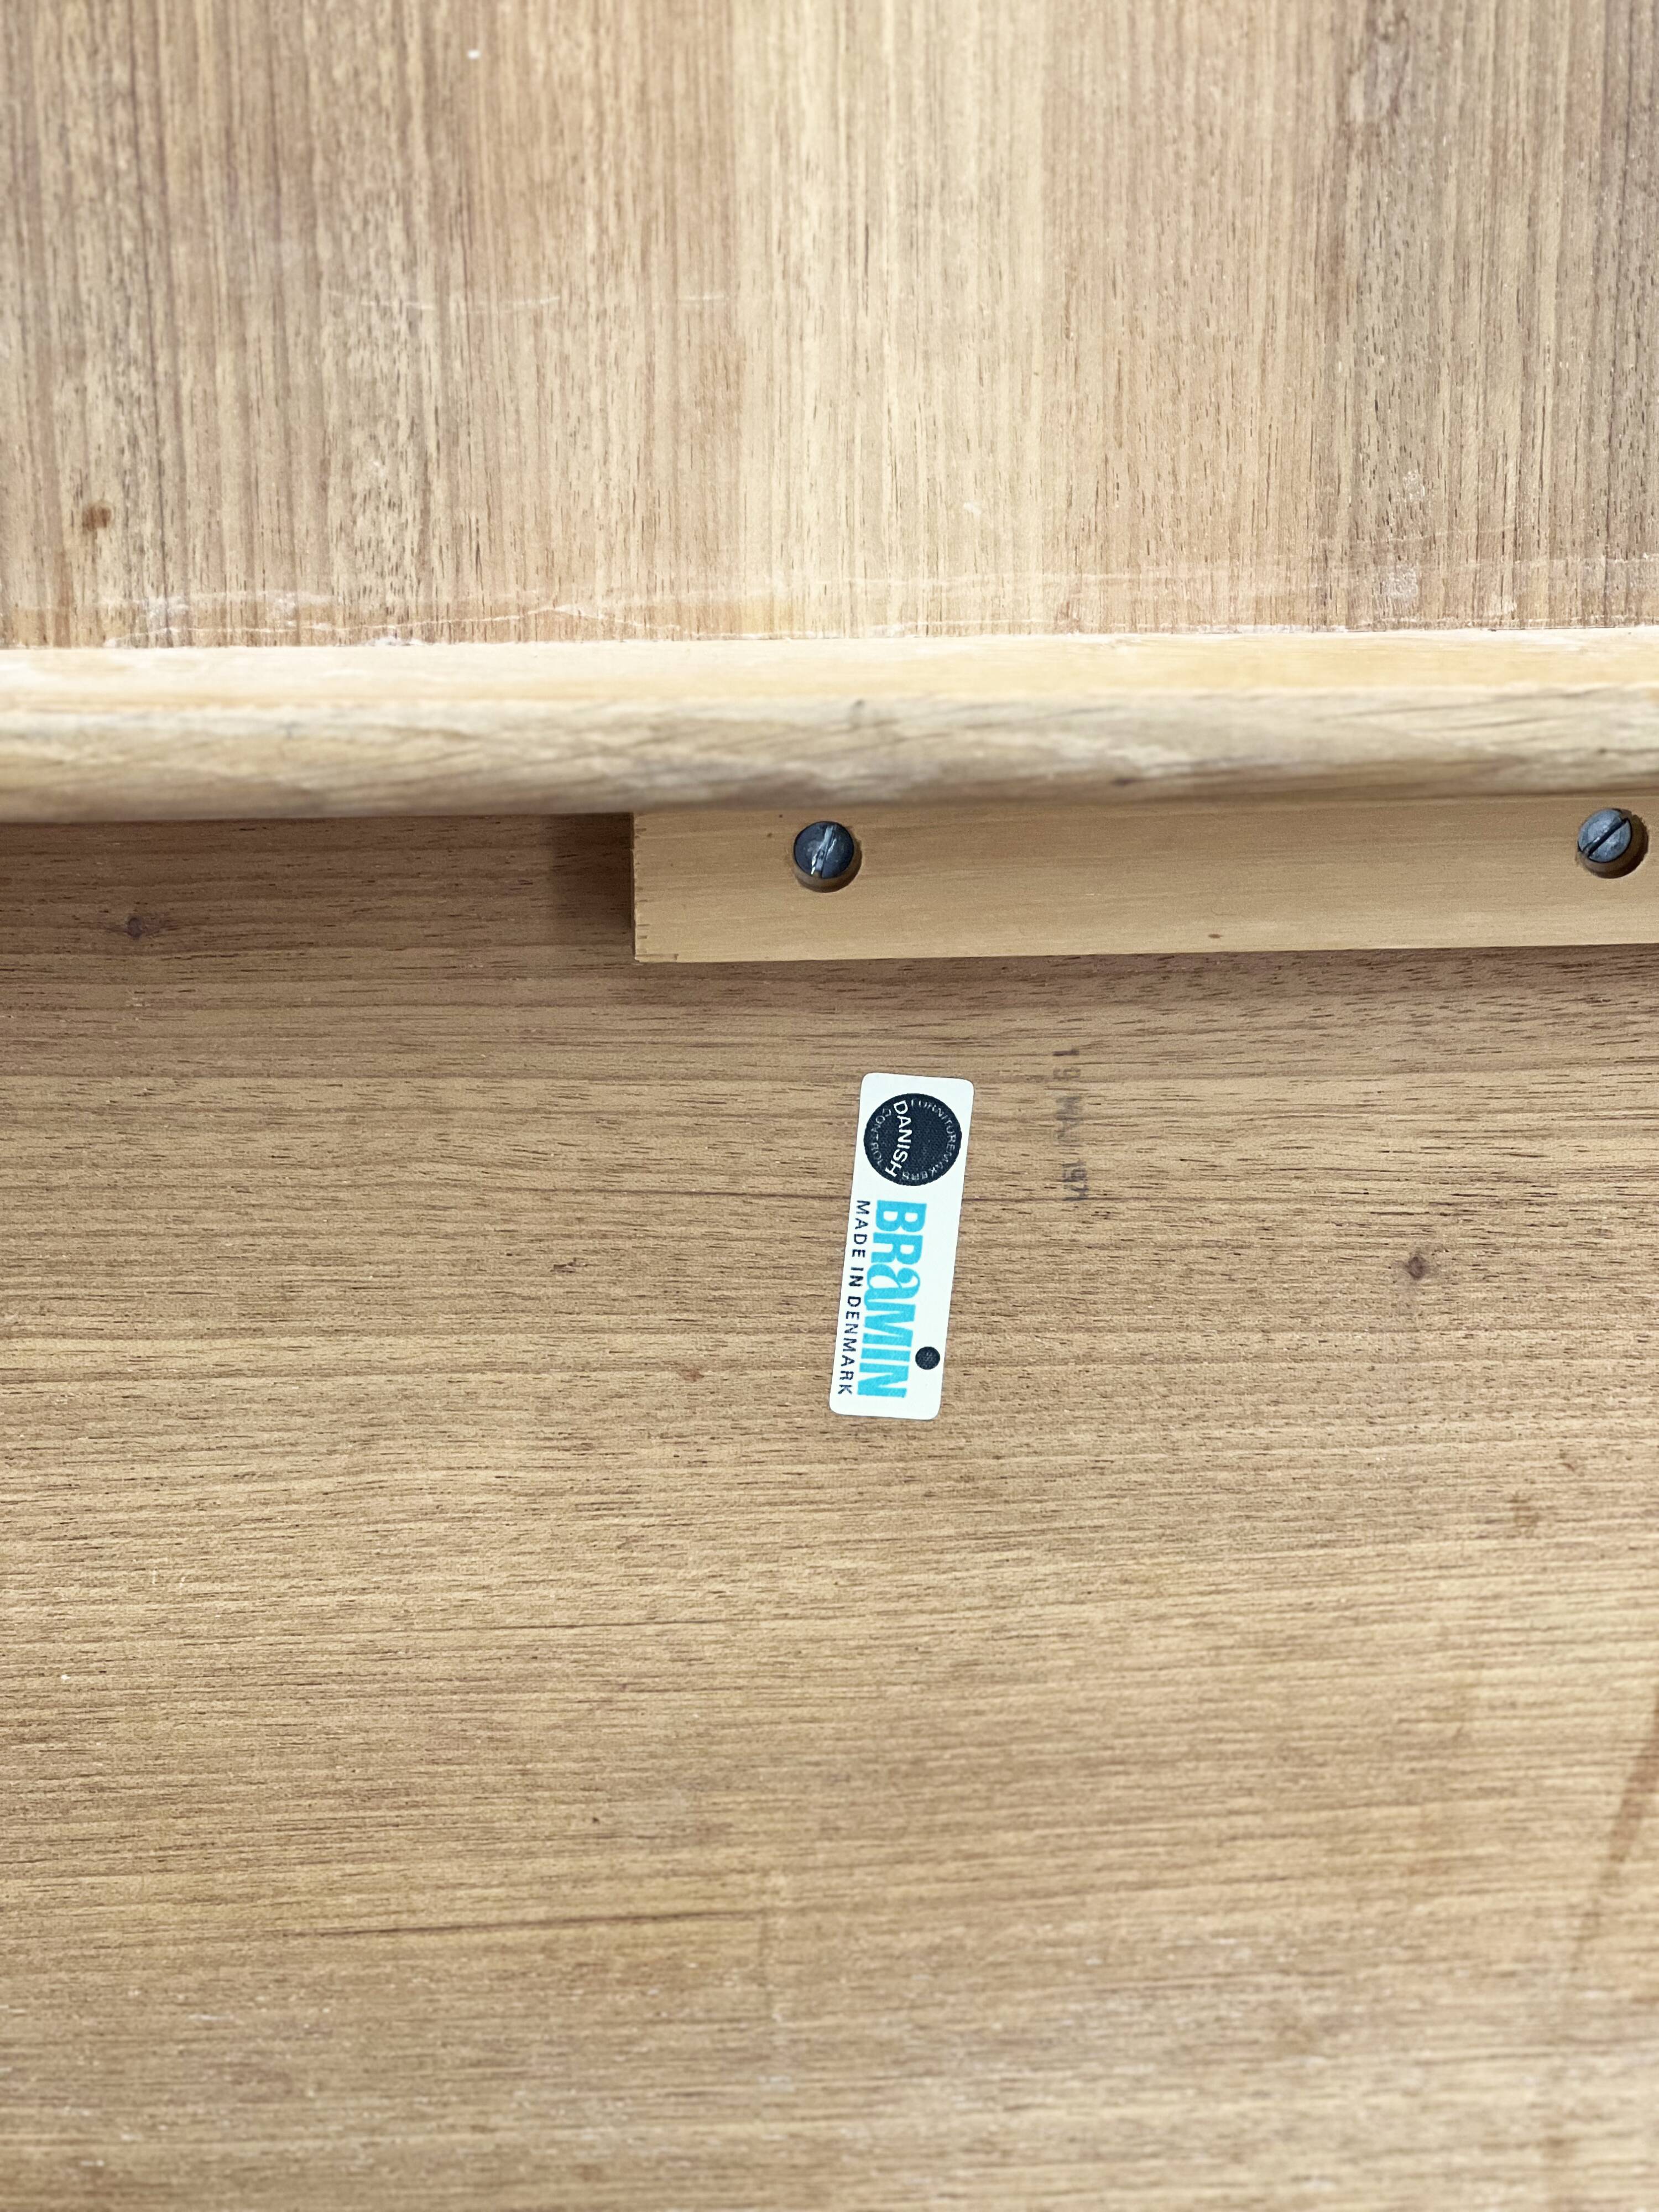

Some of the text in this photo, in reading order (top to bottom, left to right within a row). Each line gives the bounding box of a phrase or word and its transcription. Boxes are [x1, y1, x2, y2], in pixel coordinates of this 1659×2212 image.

[870, 1108, 891, 1166] CONTROL
[885, 1100, 912, 1177] DANISH
[838, 1200, 871, 1395] MADE IN DENMARK
